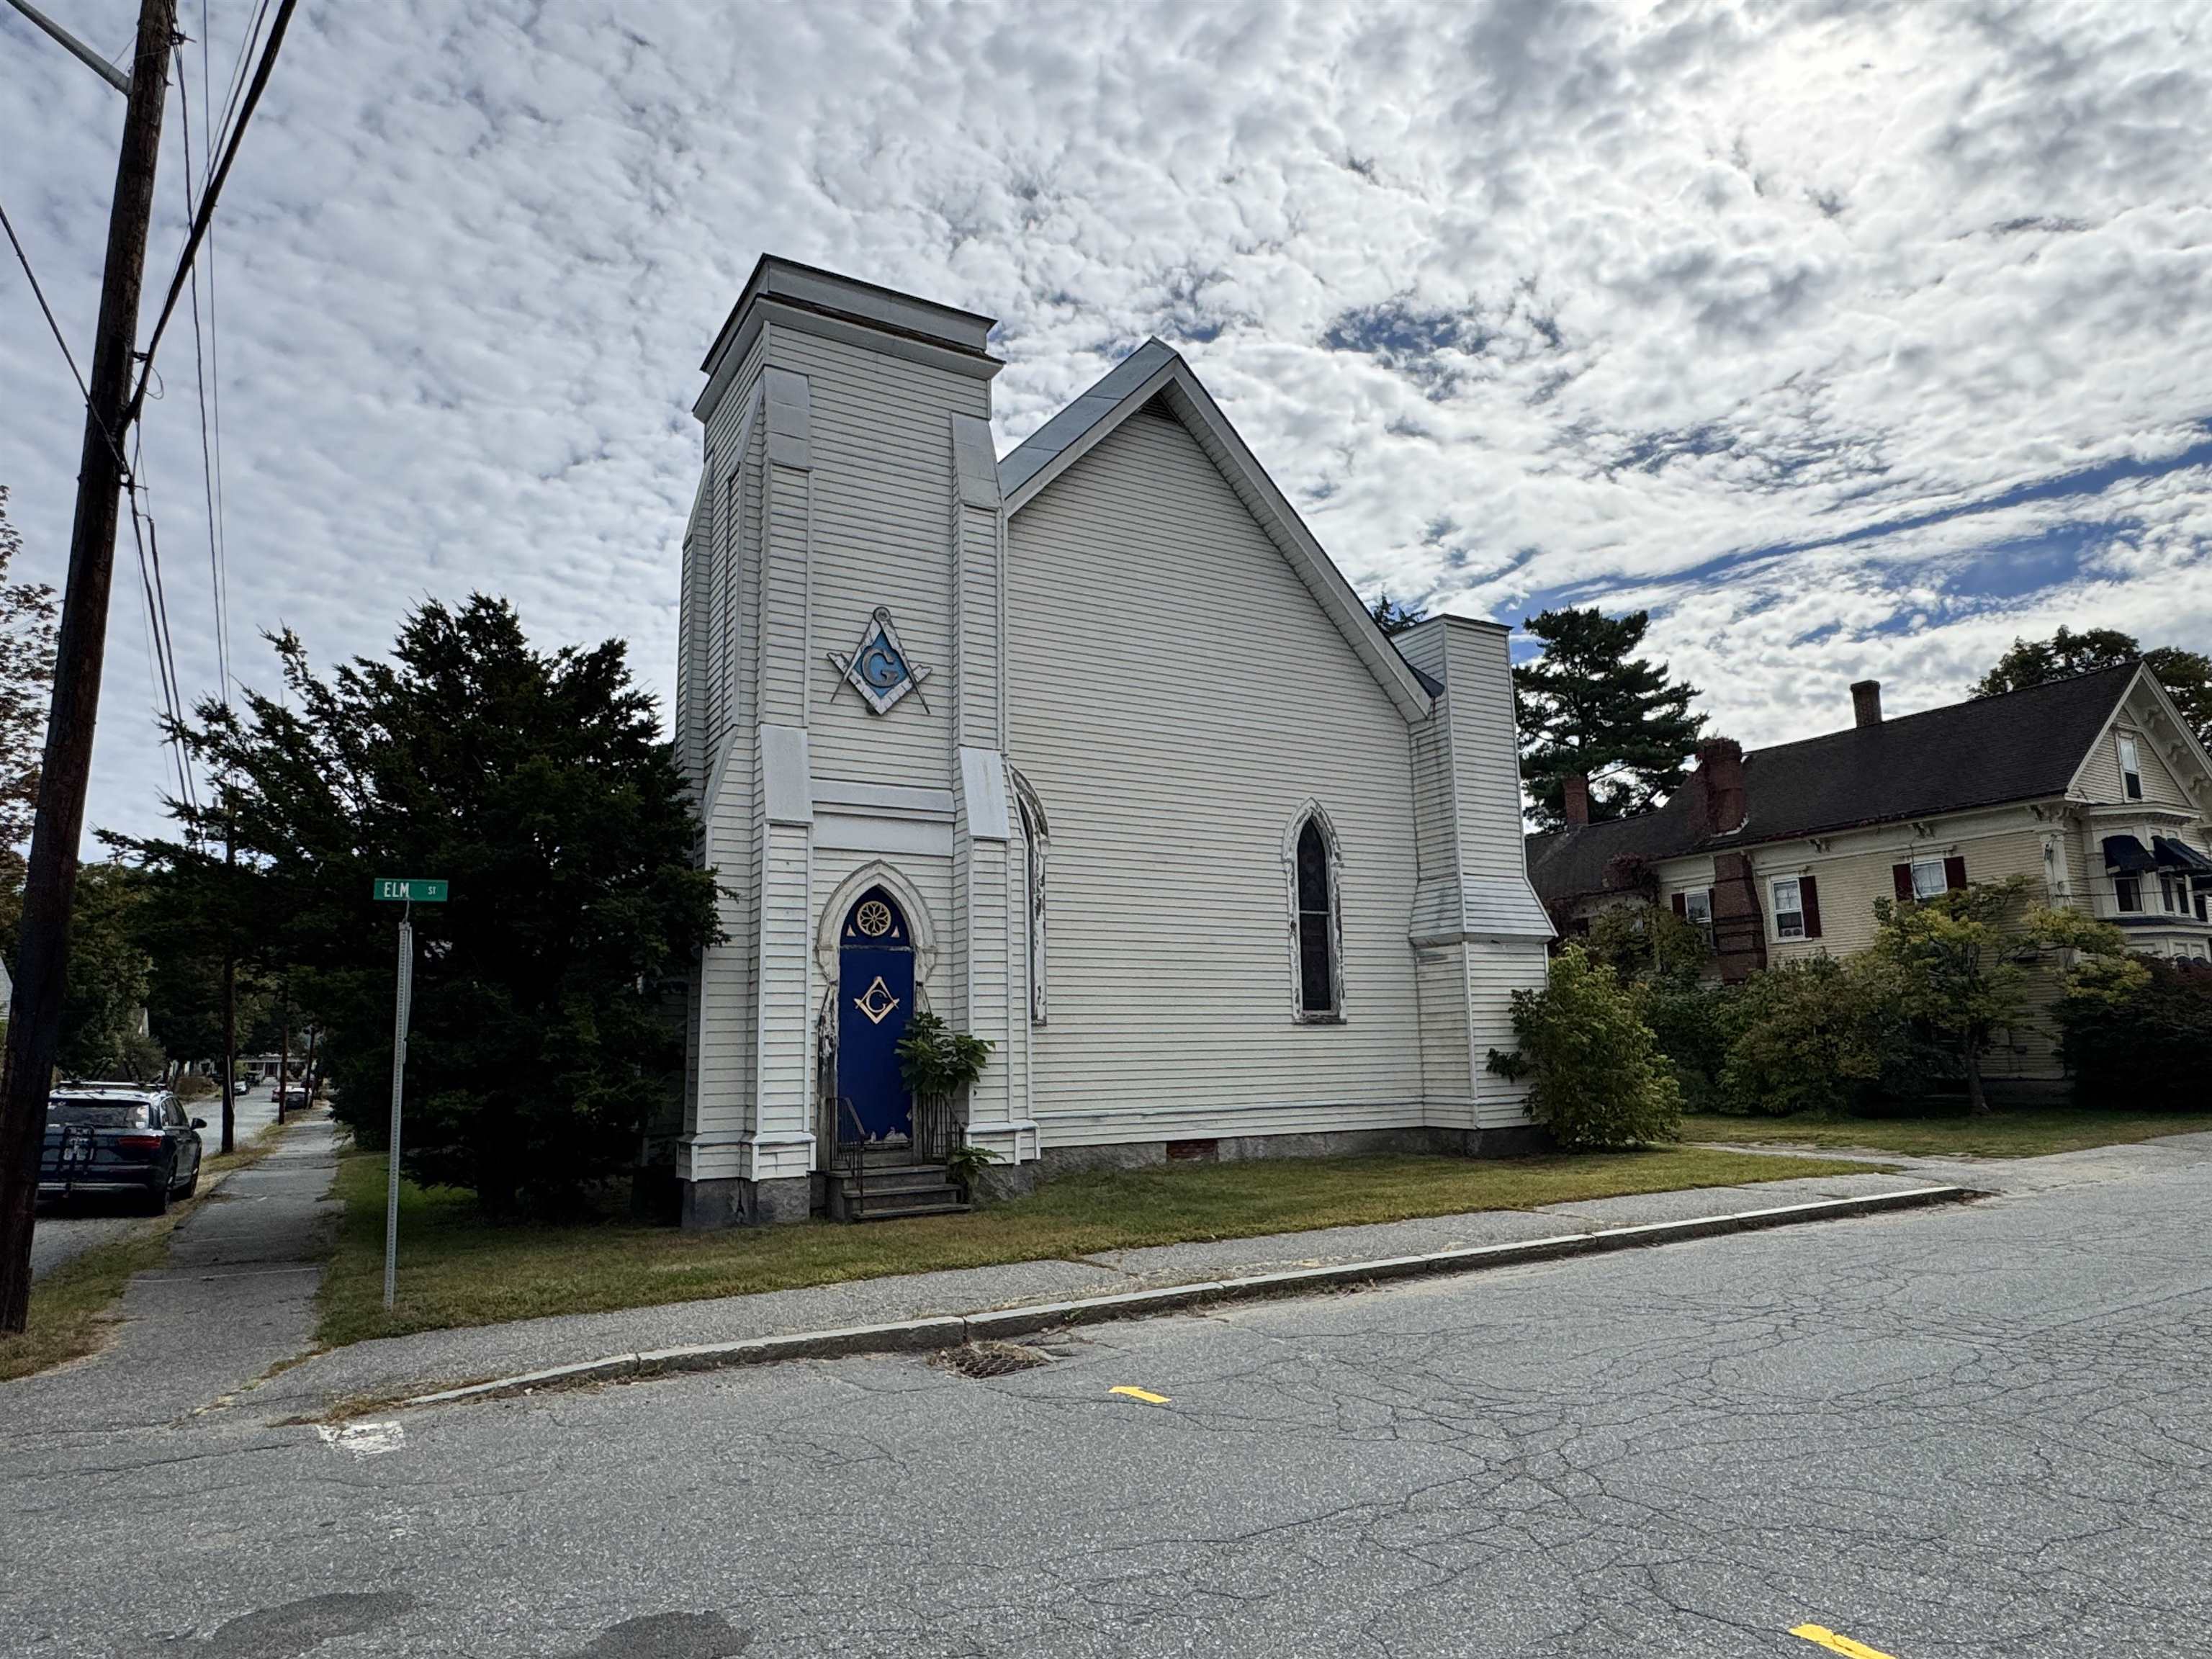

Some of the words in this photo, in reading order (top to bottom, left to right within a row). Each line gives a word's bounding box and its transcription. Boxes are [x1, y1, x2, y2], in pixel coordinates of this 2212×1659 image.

[862, 648, 898, 688] G
[384, 882, 410, 898] ELM
[428, 886, 436, 895] ST
